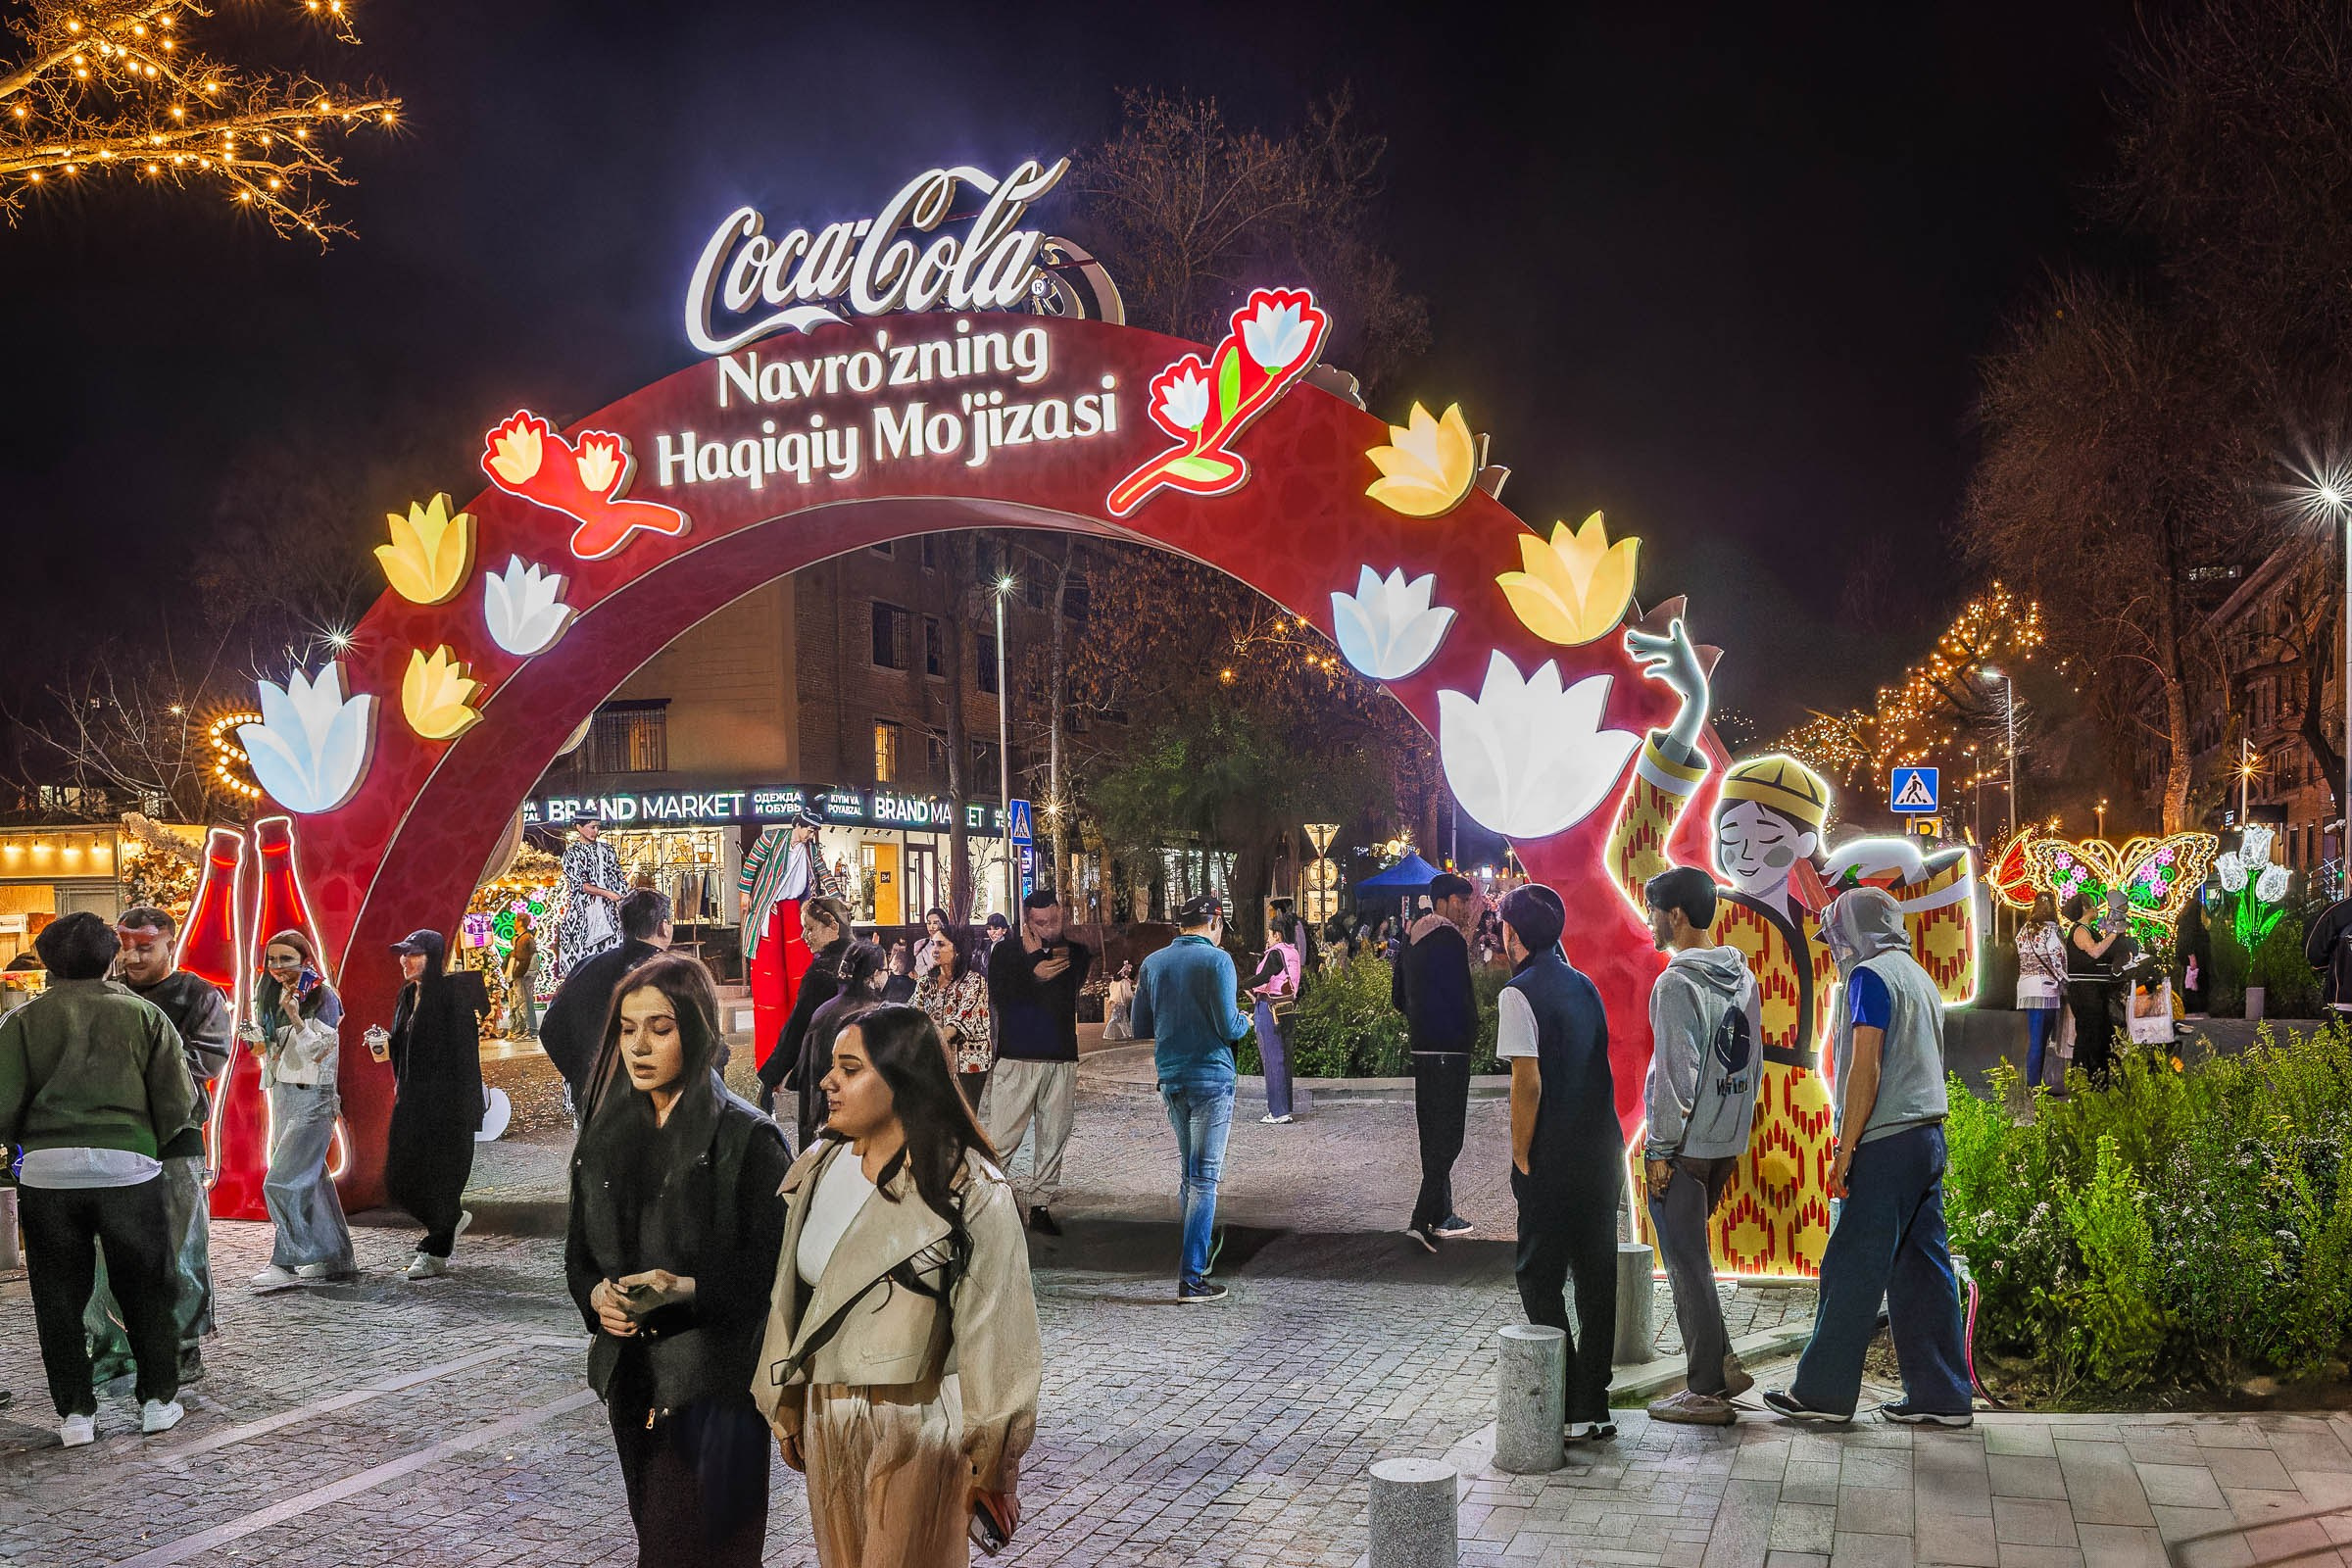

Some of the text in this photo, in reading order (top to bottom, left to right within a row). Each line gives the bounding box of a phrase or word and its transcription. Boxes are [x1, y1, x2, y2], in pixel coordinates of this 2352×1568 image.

[685, 157, 1070, 355] Coca-Cola
[717, 319, 1051, 408] Navro'zning
[656, 374, 1118, 489] Haqiqiy Mo'jizasi
[642, 792, 746, 819] MARKET
[753, 792, 803, 804] ОДЕЖДА
[755, 804, 802, 814] И ОБУВЬ
[828, 804, 863, 816] POYABZAL
[830, 794, 859, 806] KIYIM VA
[874, 797, 929, 823] BRAND
[931, 802, 984, 828] MAET
